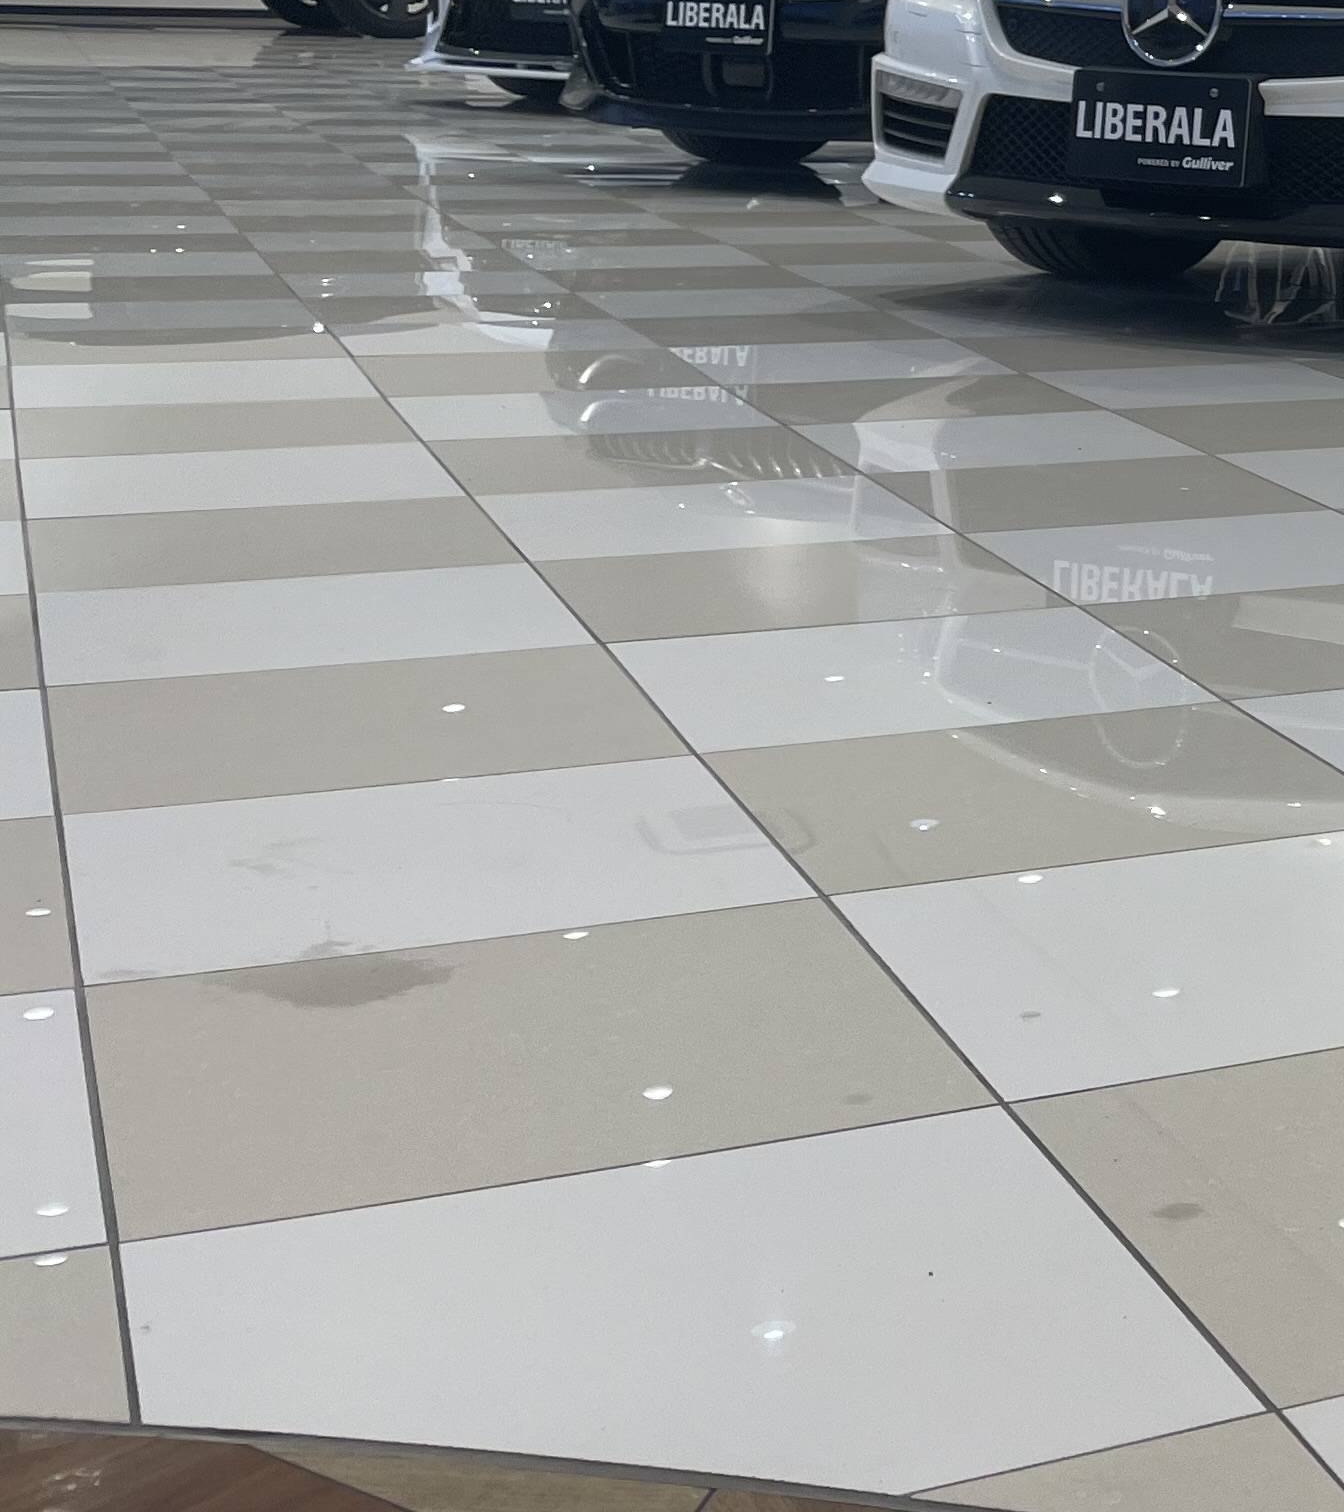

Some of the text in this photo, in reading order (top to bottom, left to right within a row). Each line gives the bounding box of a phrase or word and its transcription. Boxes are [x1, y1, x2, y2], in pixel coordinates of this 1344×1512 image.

[665, 0, 766, 31] LIBERALA
[1075, 99, 1236, 149] LIBERALA
[1181, 155, 1235, 172] Gulliver
